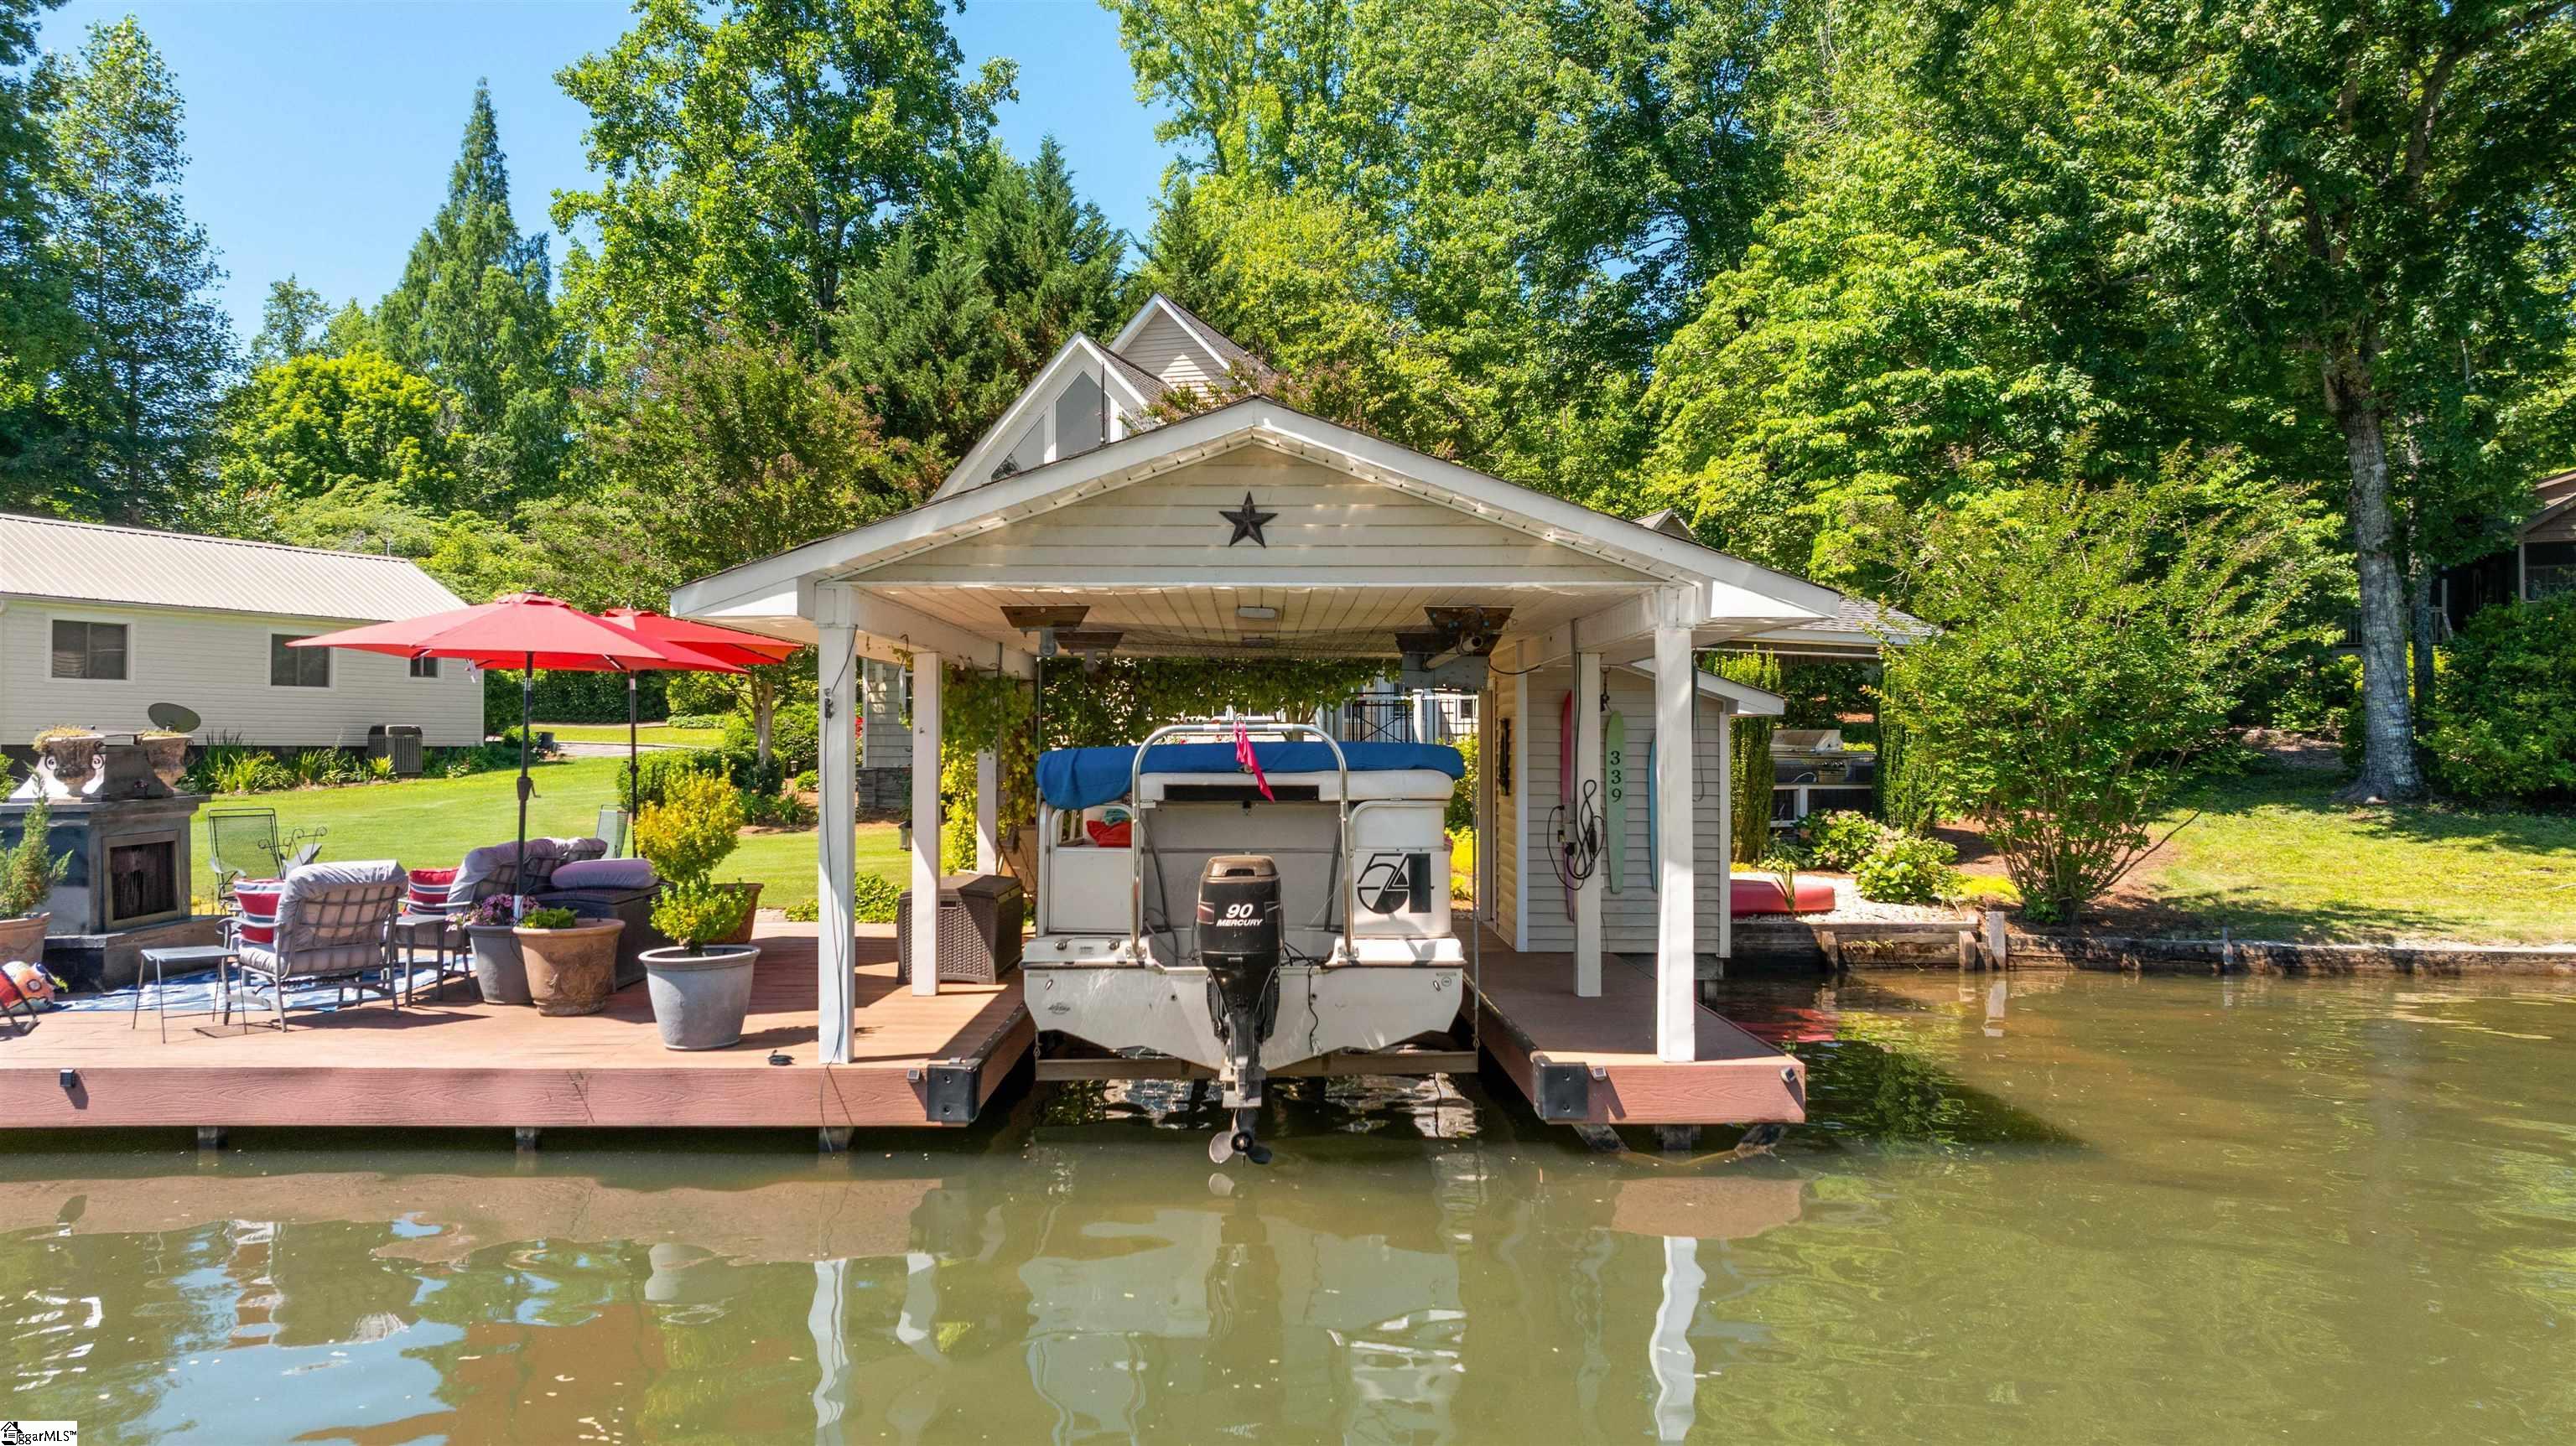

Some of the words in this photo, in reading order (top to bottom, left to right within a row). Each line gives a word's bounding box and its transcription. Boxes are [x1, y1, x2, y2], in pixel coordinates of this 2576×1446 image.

[1610, 750, 1622, 803] 339
[1226, 904, 1254, 919] 90
[1216, 919, 1263, 927] MERCURY
